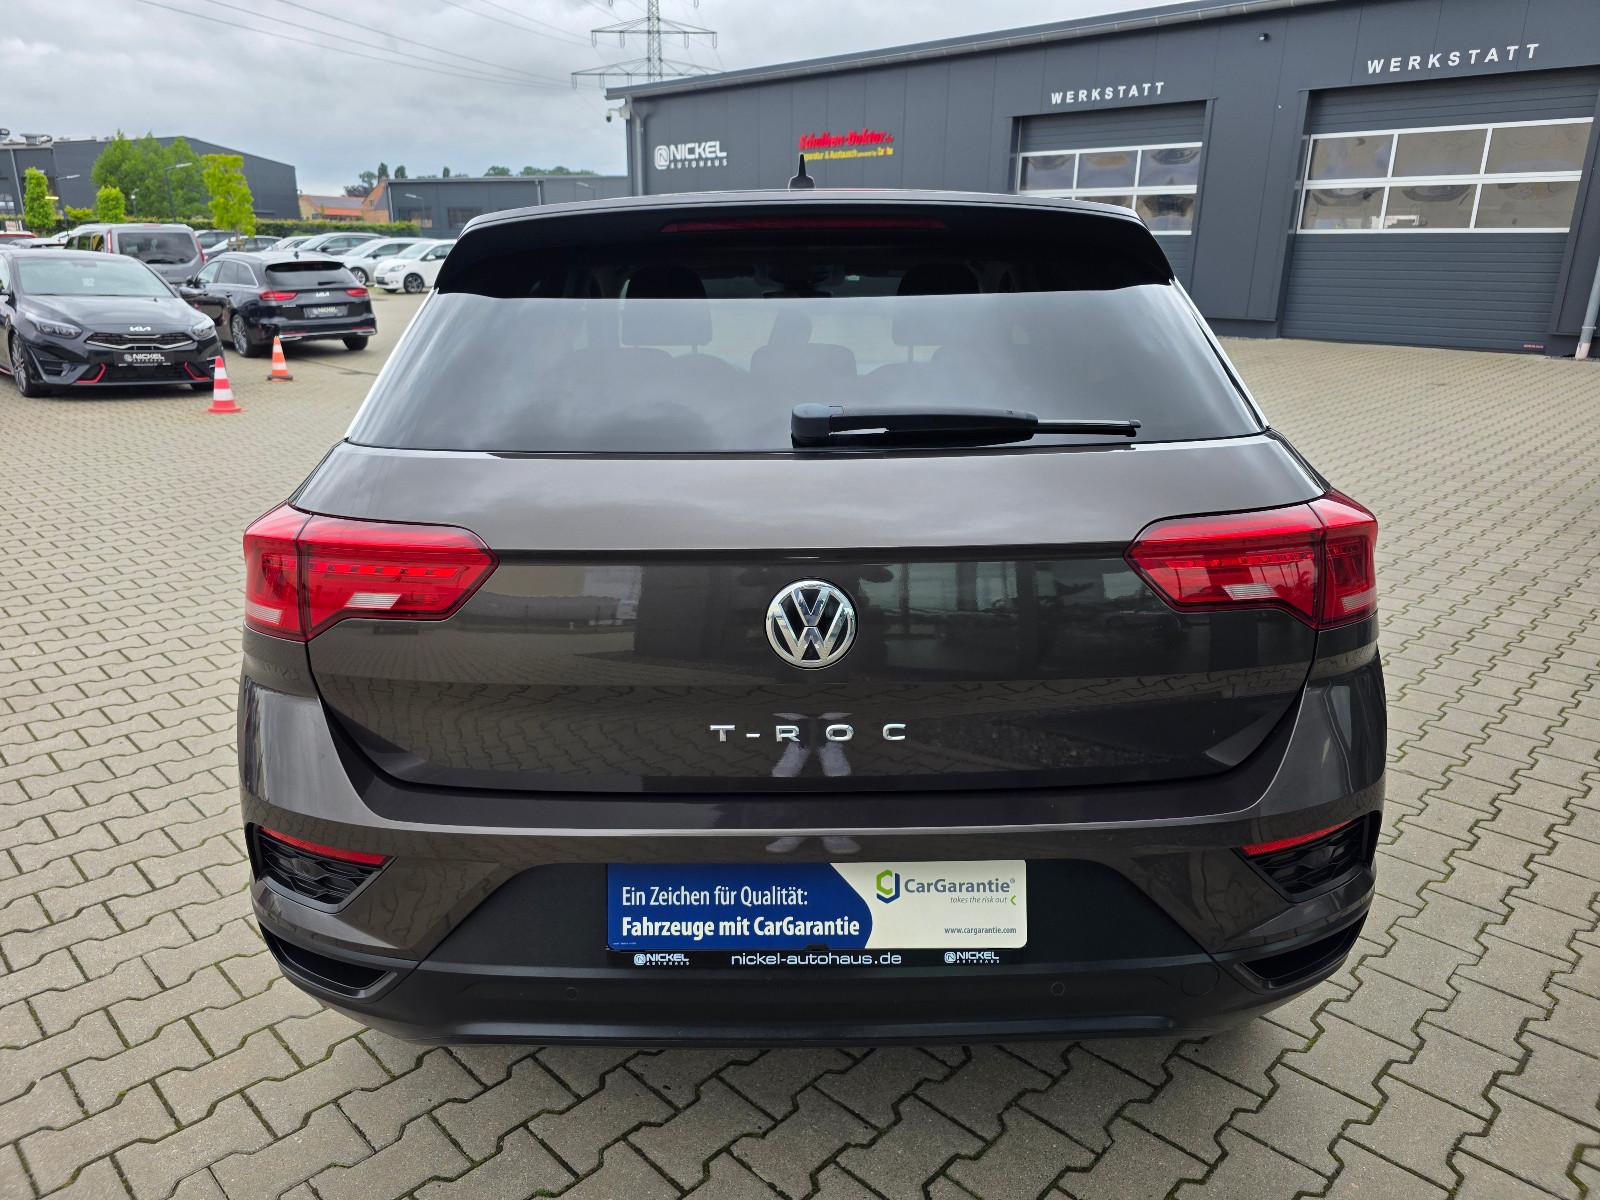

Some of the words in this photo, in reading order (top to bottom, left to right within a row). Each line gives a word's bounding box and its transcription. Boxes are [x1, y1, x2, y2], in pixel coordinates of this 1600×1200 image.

[1368, 43, 1541, 75] WERKSTATT
[1050, 81, 1166, 105] WERKSTATT
[669, 140, 728, 160] NICKEL
[670, 158, 728, 169] AUTOHAUS
[622, 887, 646, 906] Ein
[650, 887, 710, 906] Zeichen
[713, 887, 737, 906] für
[741, 886, 808, 908] Qualität:
[950, 896, 970, 904] takes
[970, 896, 981, 904] the
[982, 896, 994, 904] risk
[995, 896, 1008, 904] out
[622, 916, 715, 940] Fahrzeuge
[719, 916, 750, 936] mit
[754, 916, 860, 936] CarGarantie
[944, 926, 1017, 935] www.cargarantie.com
[646, 953, 690, 962] NICKEL
[731, 952, 902, 965] nickel-autohaus.de
[956, 951, 1000, 960] NICKEL
